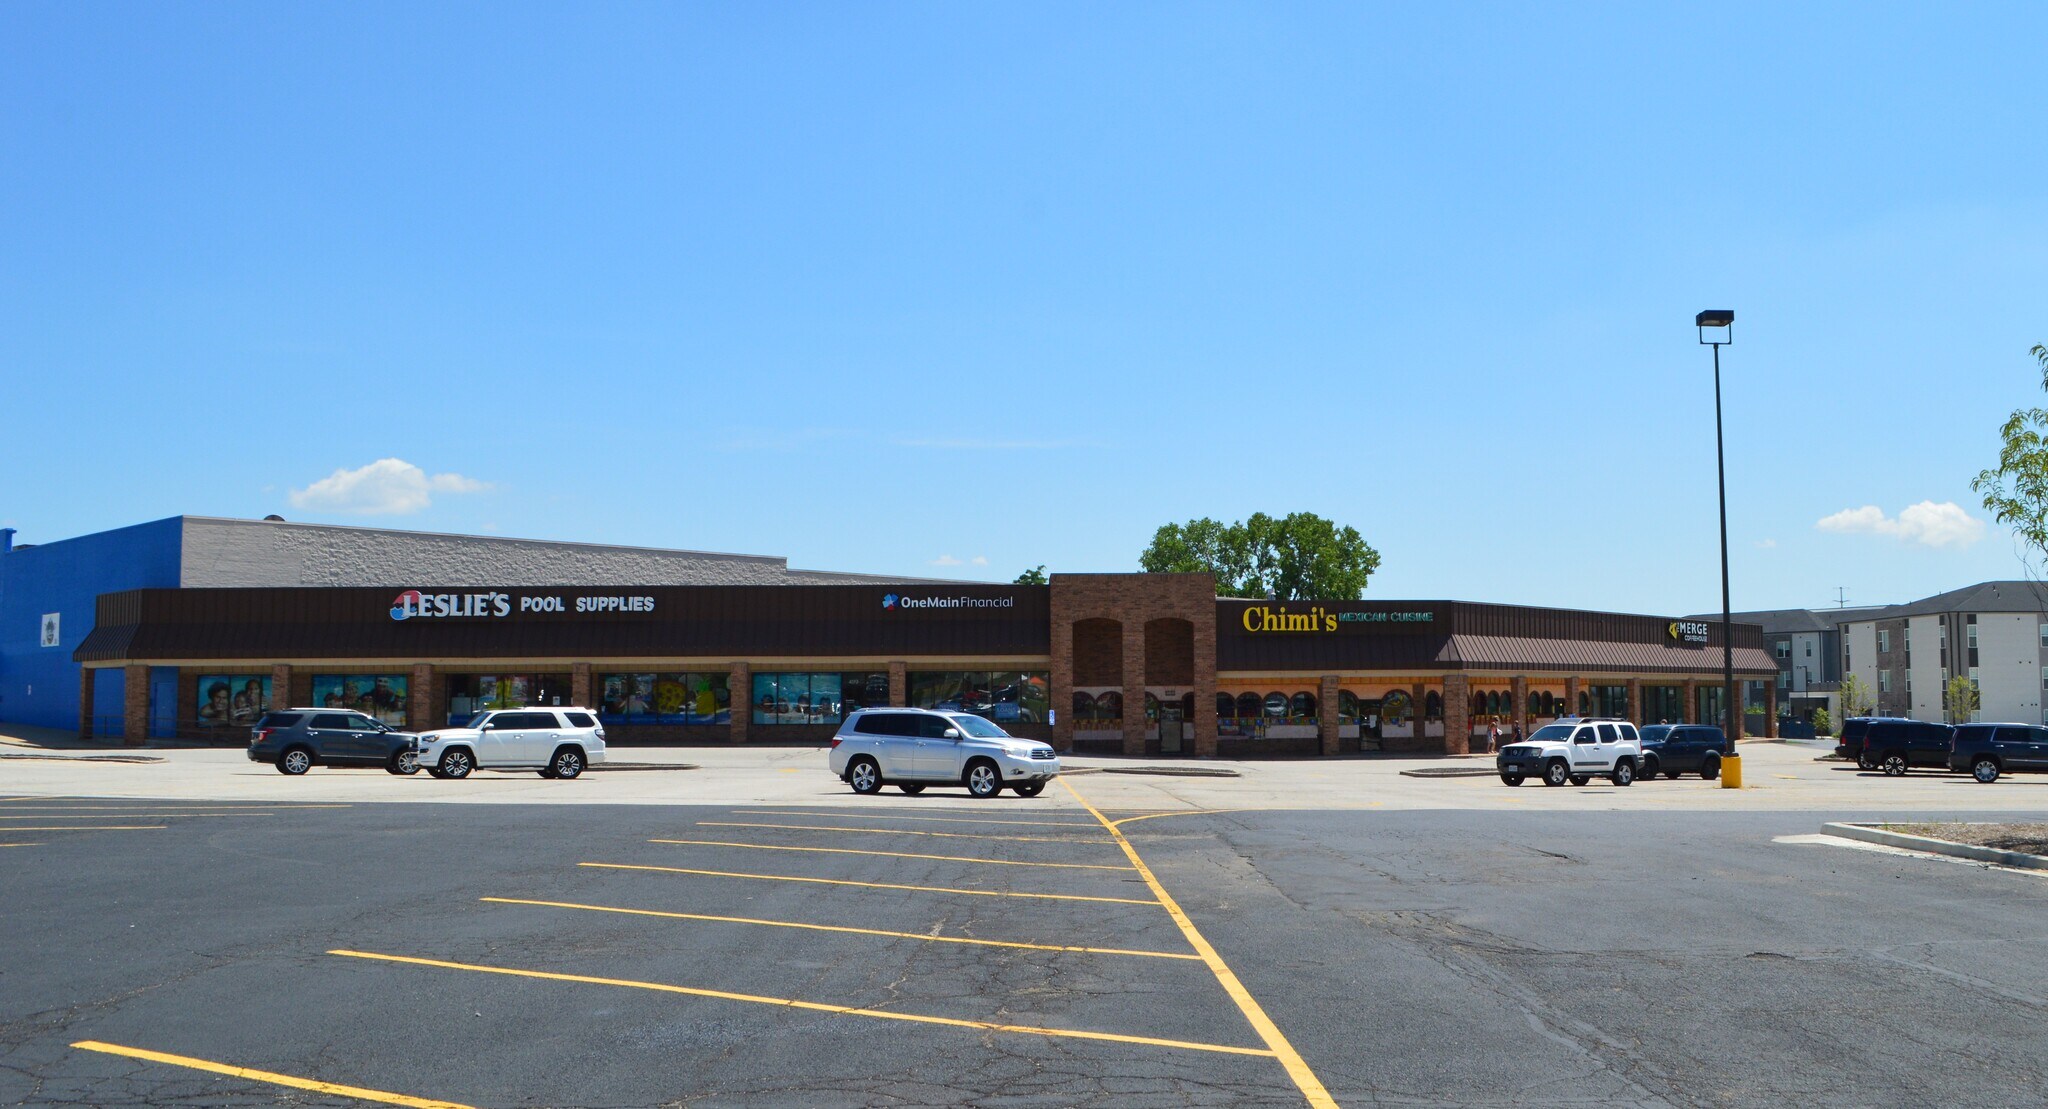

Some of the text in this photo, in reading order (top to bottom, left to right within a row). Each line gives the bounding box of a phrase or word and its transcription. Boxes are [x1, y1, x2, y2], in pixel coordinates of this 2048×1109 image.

[403, 591, 655, 617] LESLIE'S POOL SUPPLIES
[1242, 606, 1338, 632] Chimi's
[1338, 611, 1434, 622] MEXICAN CUISINE
[1680, 622, 1707, 634] MERGE
